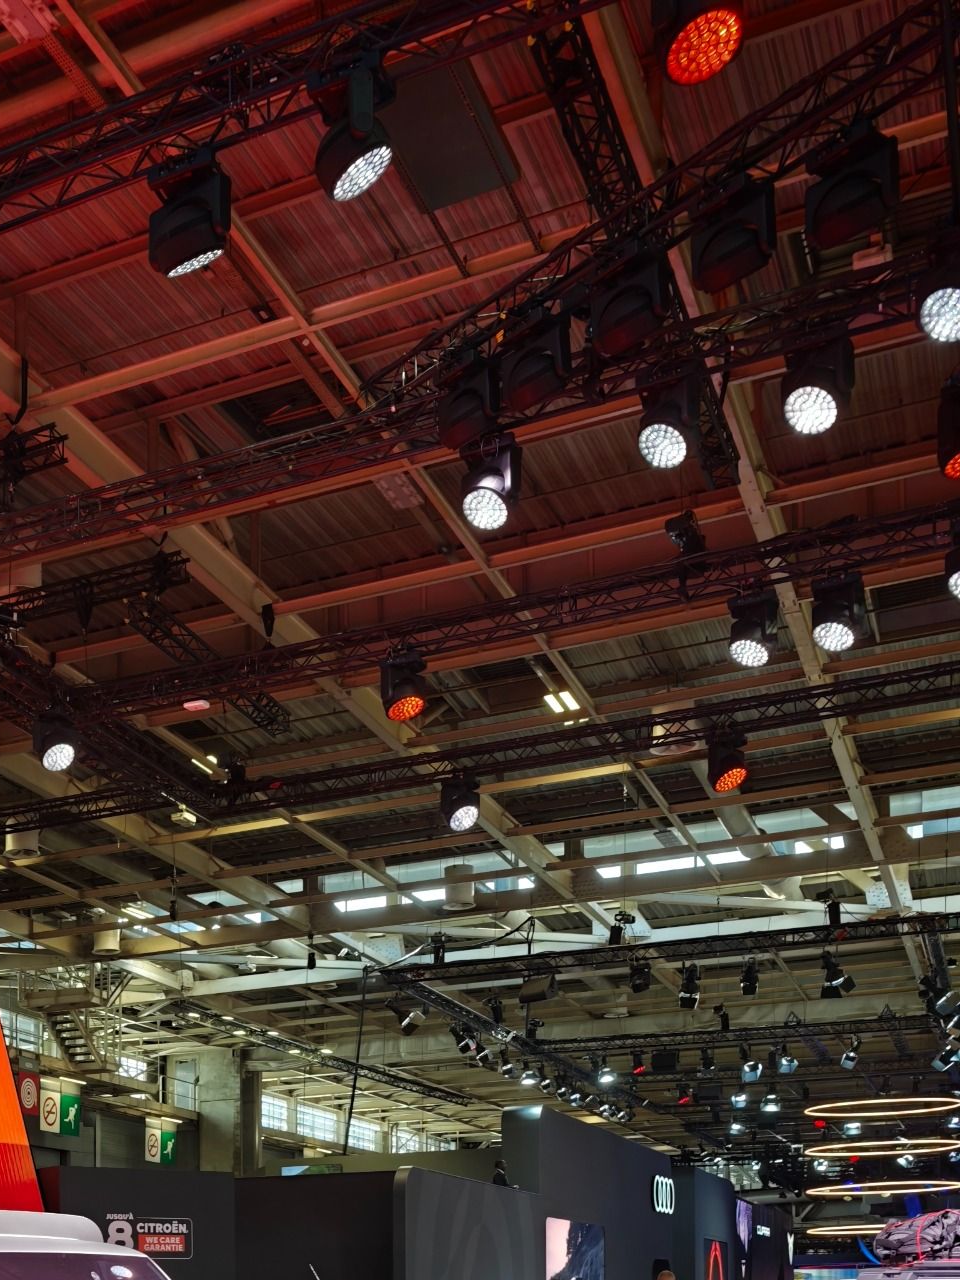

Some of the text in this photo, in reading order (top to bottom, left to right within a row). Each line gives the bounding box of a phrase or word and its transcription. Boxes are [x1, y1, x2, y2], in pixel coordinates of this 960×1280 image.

[136, 1221, 187, 1234] CITROËN
[107, 1220, 134, 1249] 8
[145, 1236, 181, 1244] WE CARE
[143, 1244, 184, 1252] GARANTIE
